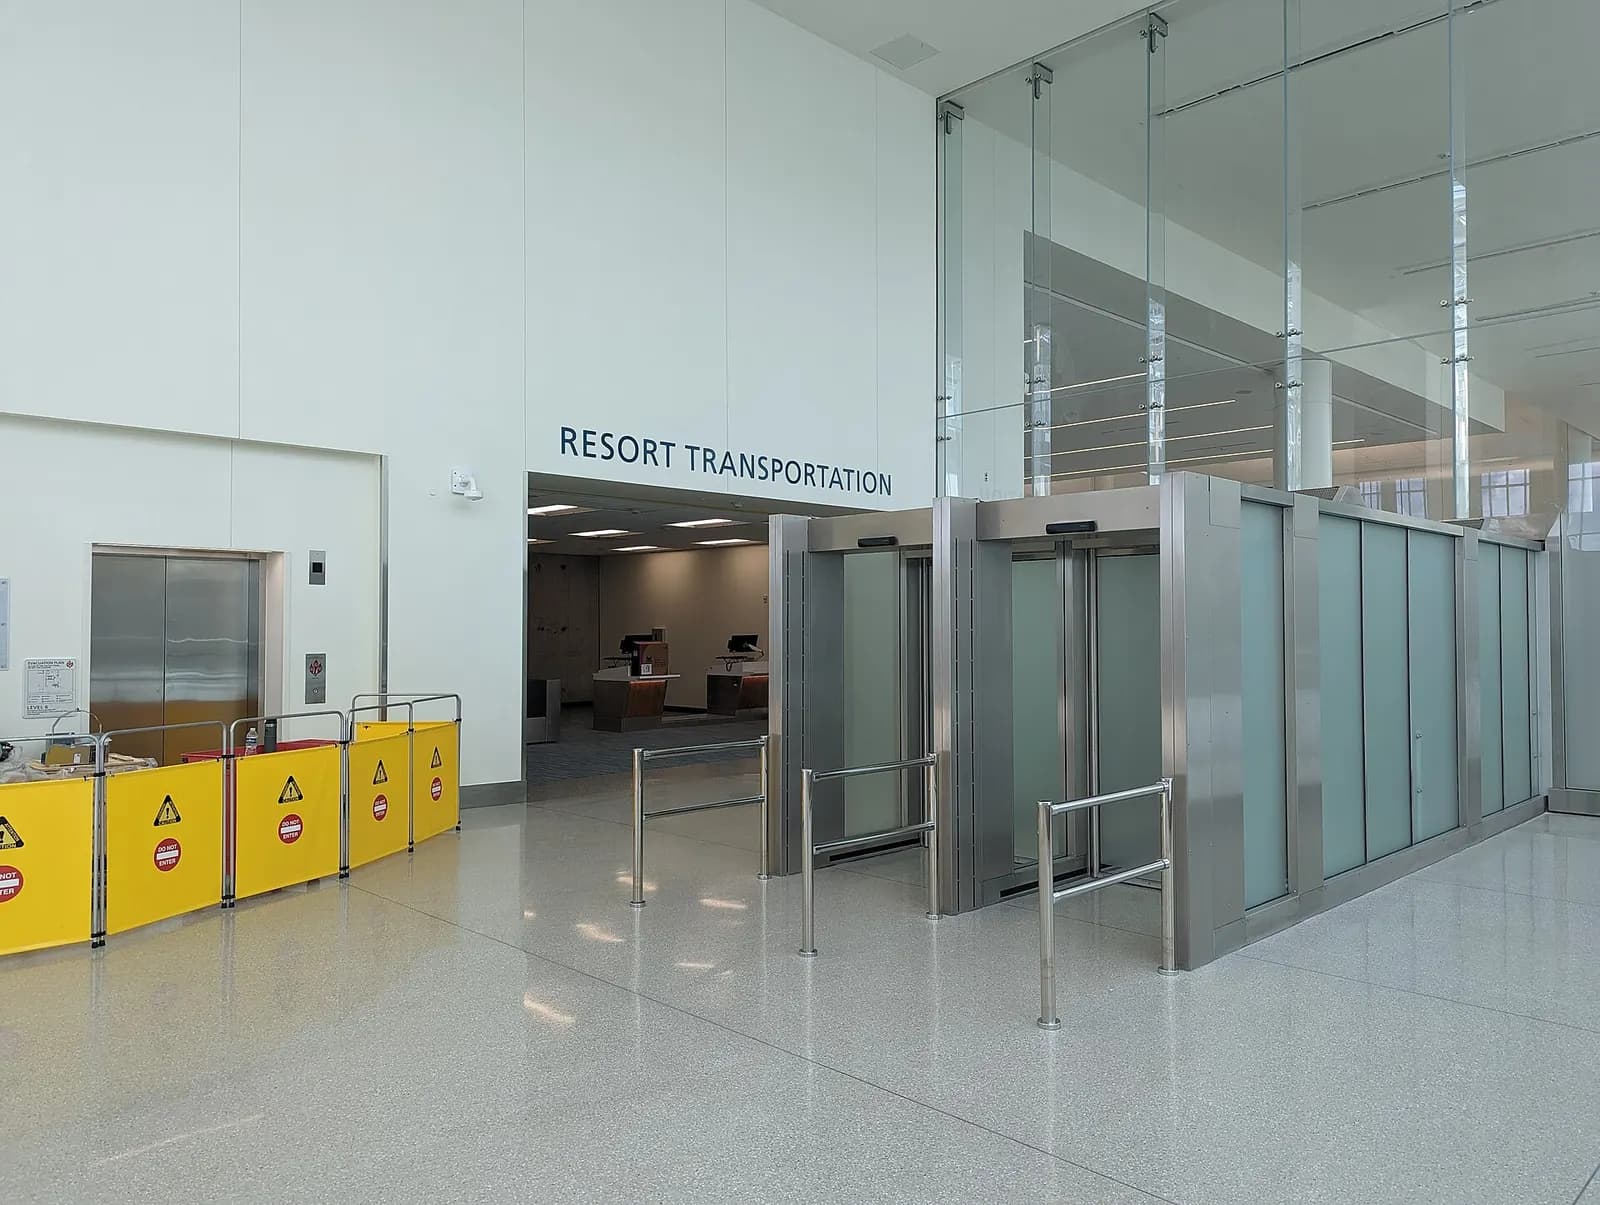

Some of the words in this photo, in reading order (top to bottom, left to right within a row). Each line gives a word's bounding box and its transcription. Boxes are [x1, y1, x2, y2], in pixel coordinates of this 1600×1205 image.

[560, 426, 676, 468] RESORT
[685, 444, 892, 497] TRANSPORTATION
[282, 832, 299, 840] ENTER
[159, 858, 176, 867] ENTER
